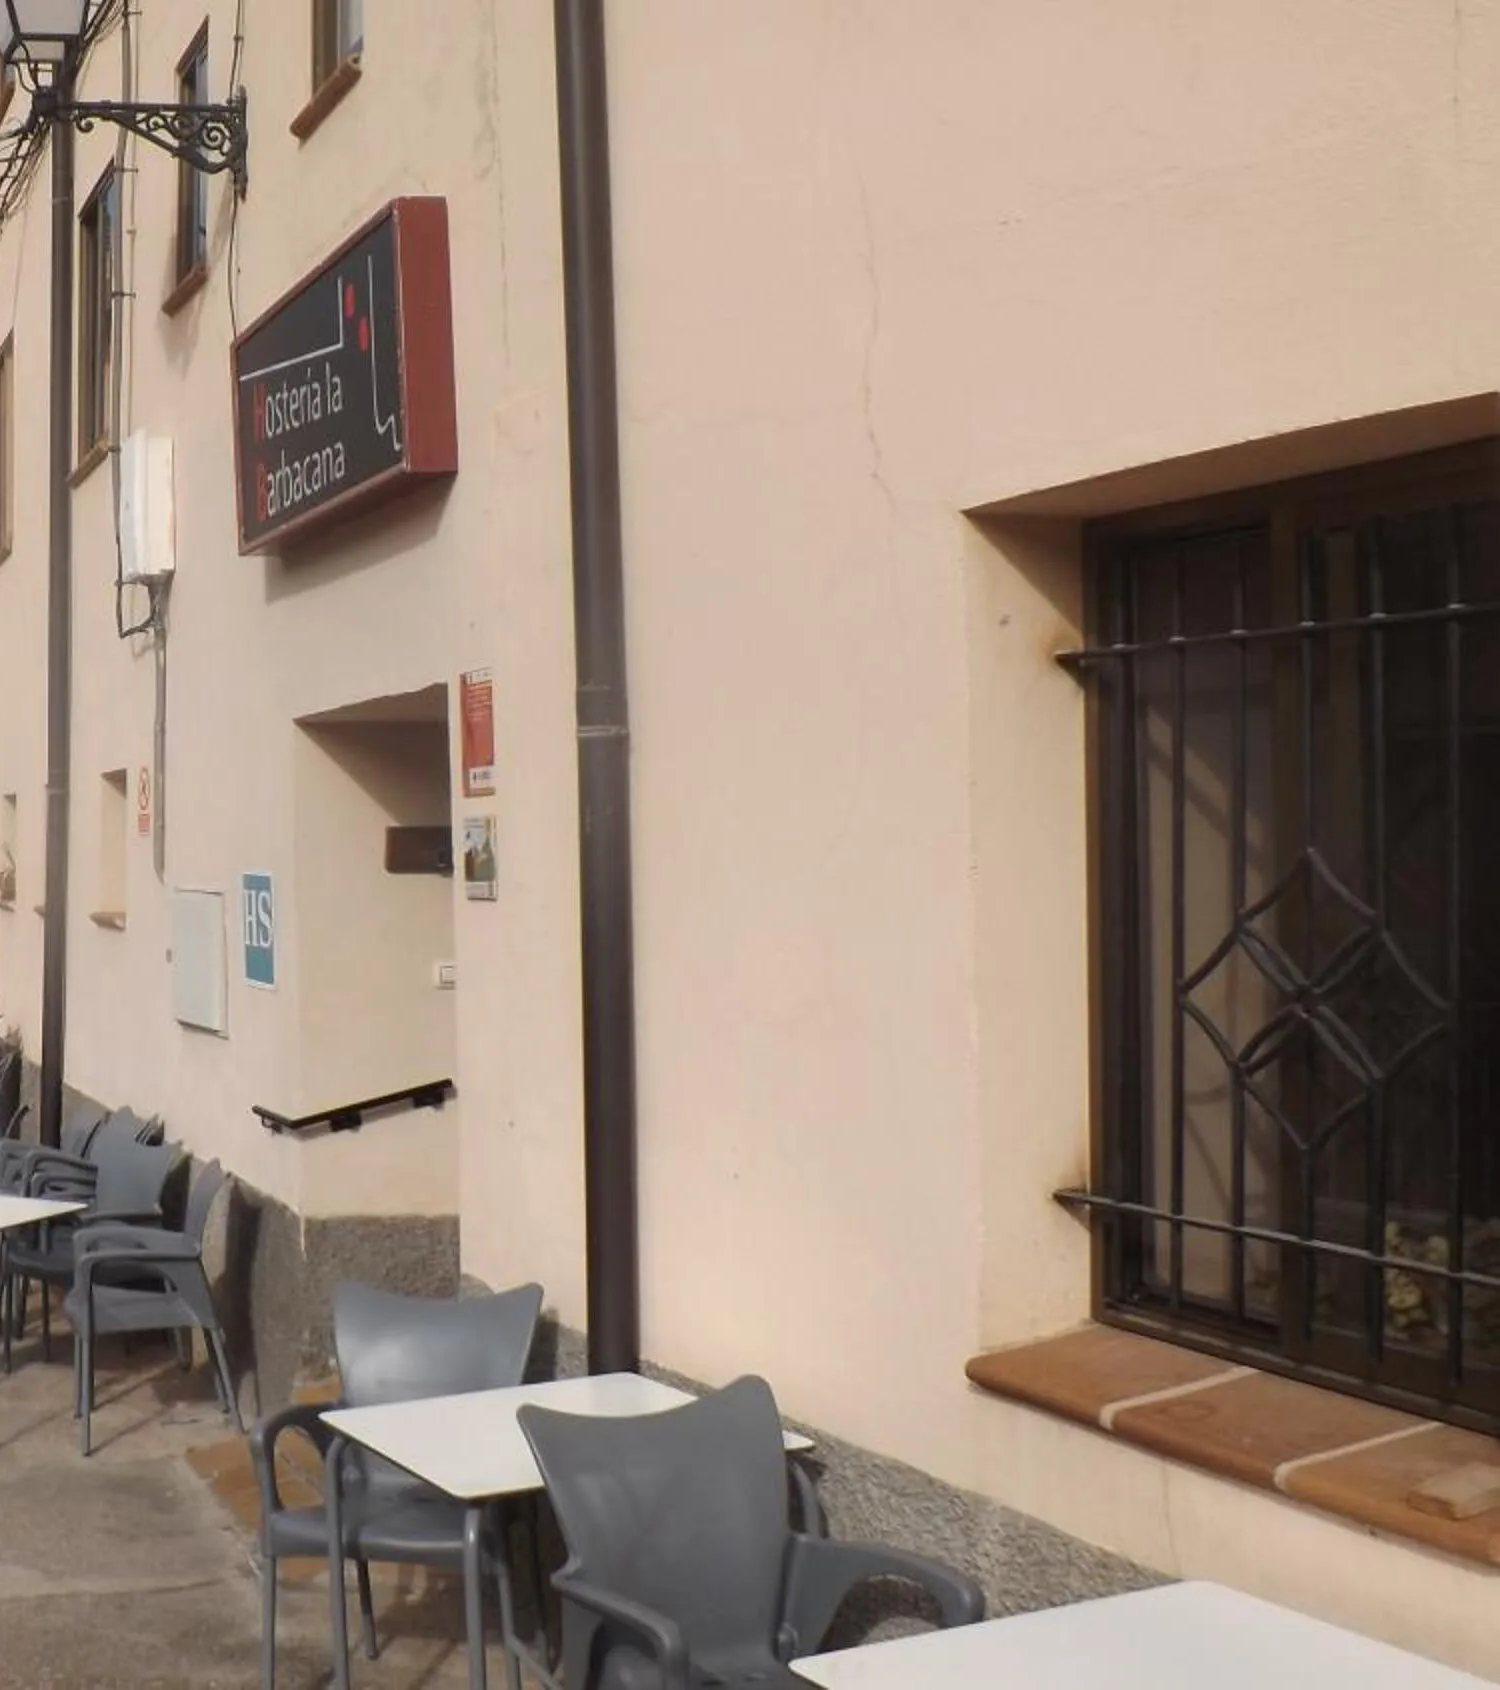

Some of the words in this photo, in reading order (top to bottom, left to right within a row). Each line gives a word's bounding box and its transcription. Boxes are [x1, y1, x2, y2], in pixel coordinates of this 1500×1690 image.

[325, 361, 343, 416] la
[256, 441, 346, 522] Barbacana
[243, 889, 272, 947] HS
